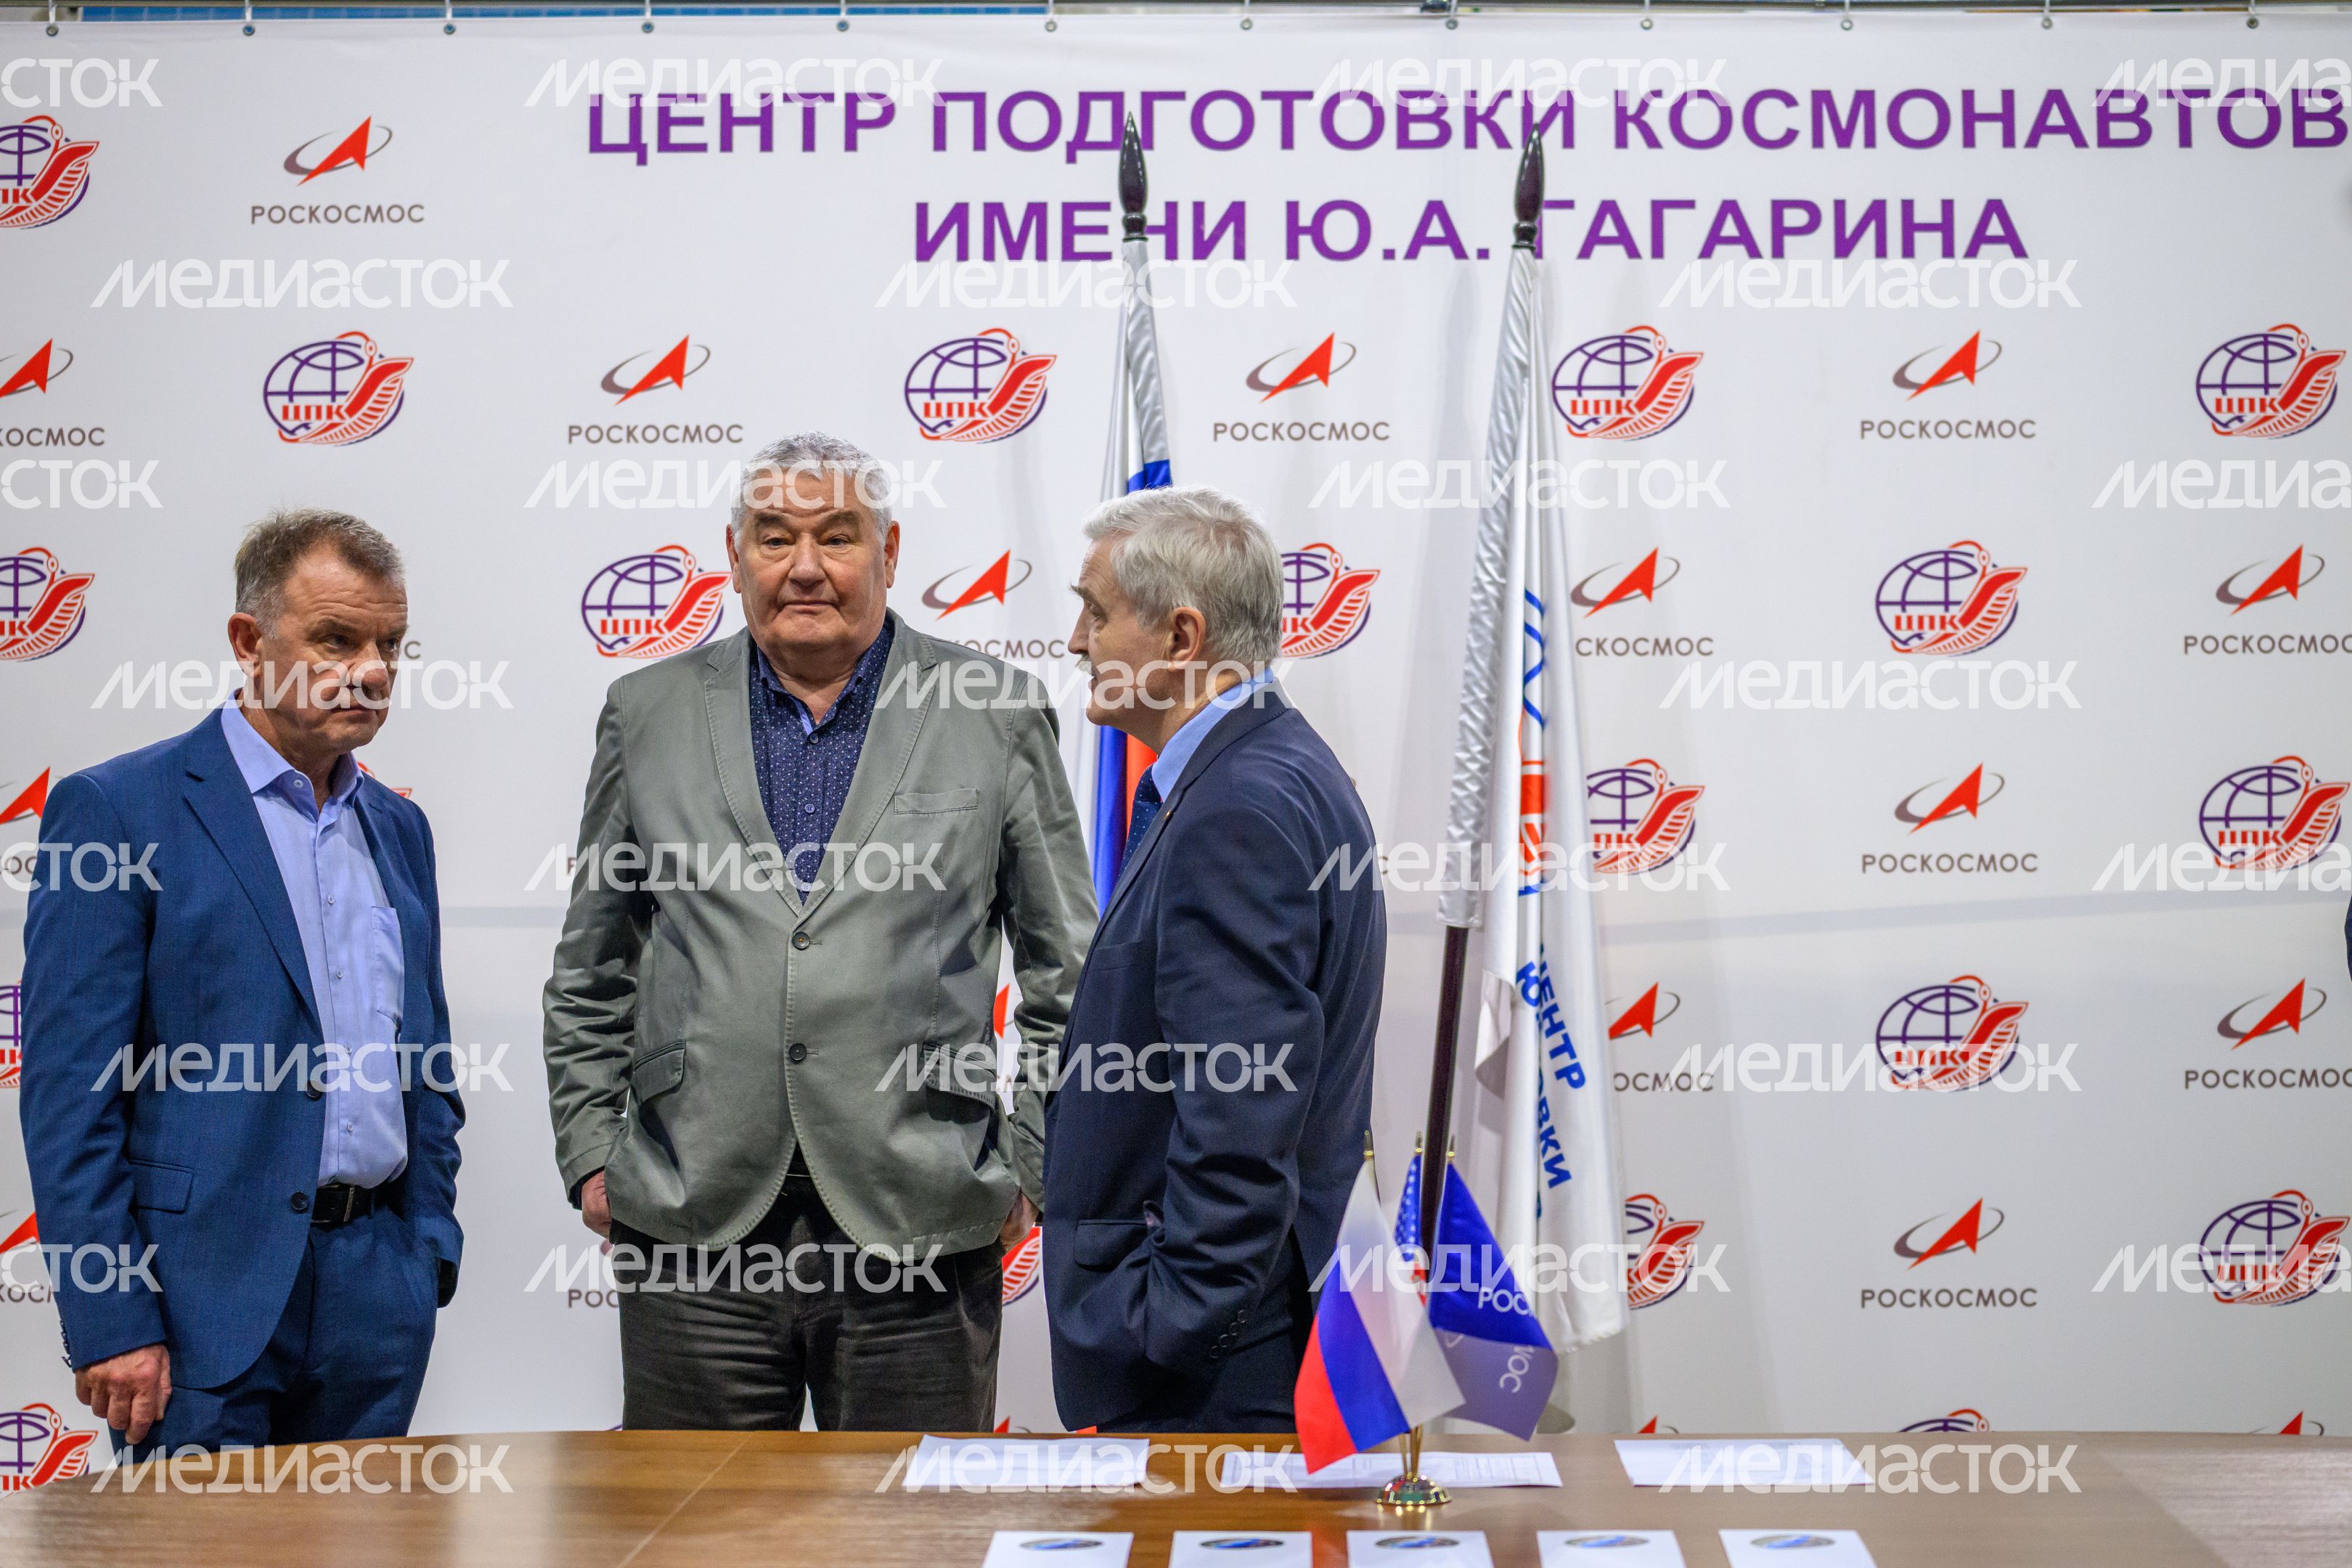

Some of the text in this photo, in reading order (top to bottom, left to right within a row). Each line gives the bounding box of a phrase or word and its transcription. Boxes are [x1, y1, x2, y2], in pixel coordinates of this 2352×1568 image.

[589, 89, 2348, 166] ЦЕНТР ПОДГОТОВКИ КОСМОНАВТОВ
[250, 203, 425, 225] РОСКОСМОС
[915, 199, 2028, 262] ИМЕНИ Ю.А. ГАГАРИНА
[282, 404, 346, 421] ЦПК
[923, 401, 989, 419] ЦПК
[1571, 399, 1636, 416] ЦПК
[2215, 397, 2280, 414] ЦПК
[0, 427, 105, 447] ОСМОС
[568, 424, 743, 444] РОСКОСМОС
[1214, 421, 1390, 442] РОСКОСМОС
[1860, 419, 2037, 440] РОСКОСМОС
[600, 618, 666, 635] ЦПК
[1895, 615, 1960, 632] ЦПК
[1575, 637, 1714, 657] СКОСМОС
[1593, 833, 1634, 849] ПК
[2218, 830, 2284, 847] ЦПК
[1861, 852, 2038, 874] РОСКОСМОС
[1614, 1071, 1714, 1092] ОСМОС
[1861, 1287, 2038, 1309] РОСКОСМОС
